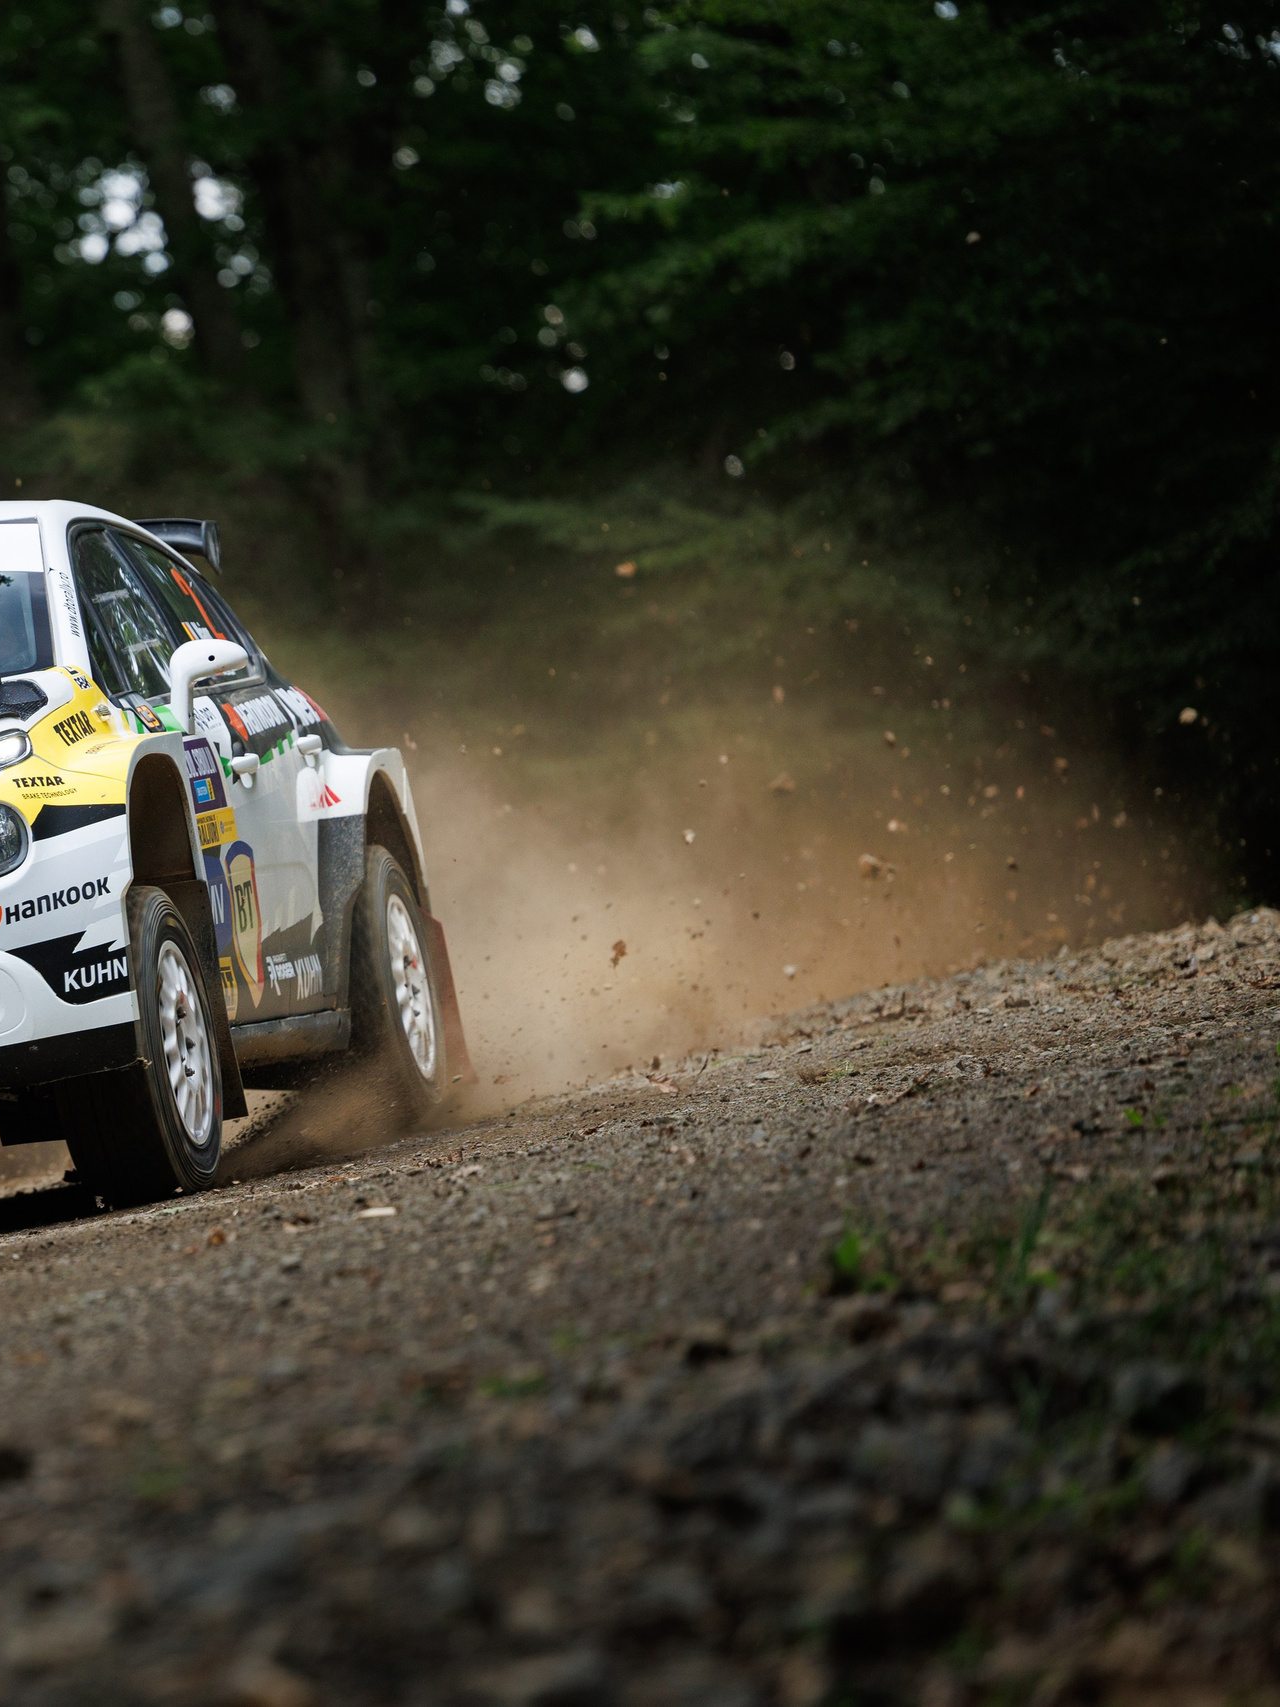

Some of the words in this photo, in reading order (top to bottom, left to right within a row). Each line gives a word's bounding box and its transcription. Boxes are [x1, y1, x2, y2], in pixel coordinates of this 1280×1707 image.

[53, 710, 97, 747] TEXTAR
[12, 775, 65, 789] TEXTAR
[22, 791, 40, 800] BRAKE
[40, 787, 78, 799] TECHNOLOGY
[234, 880, 254, 934] BT
[63, 956, 128, 993] KUHN
